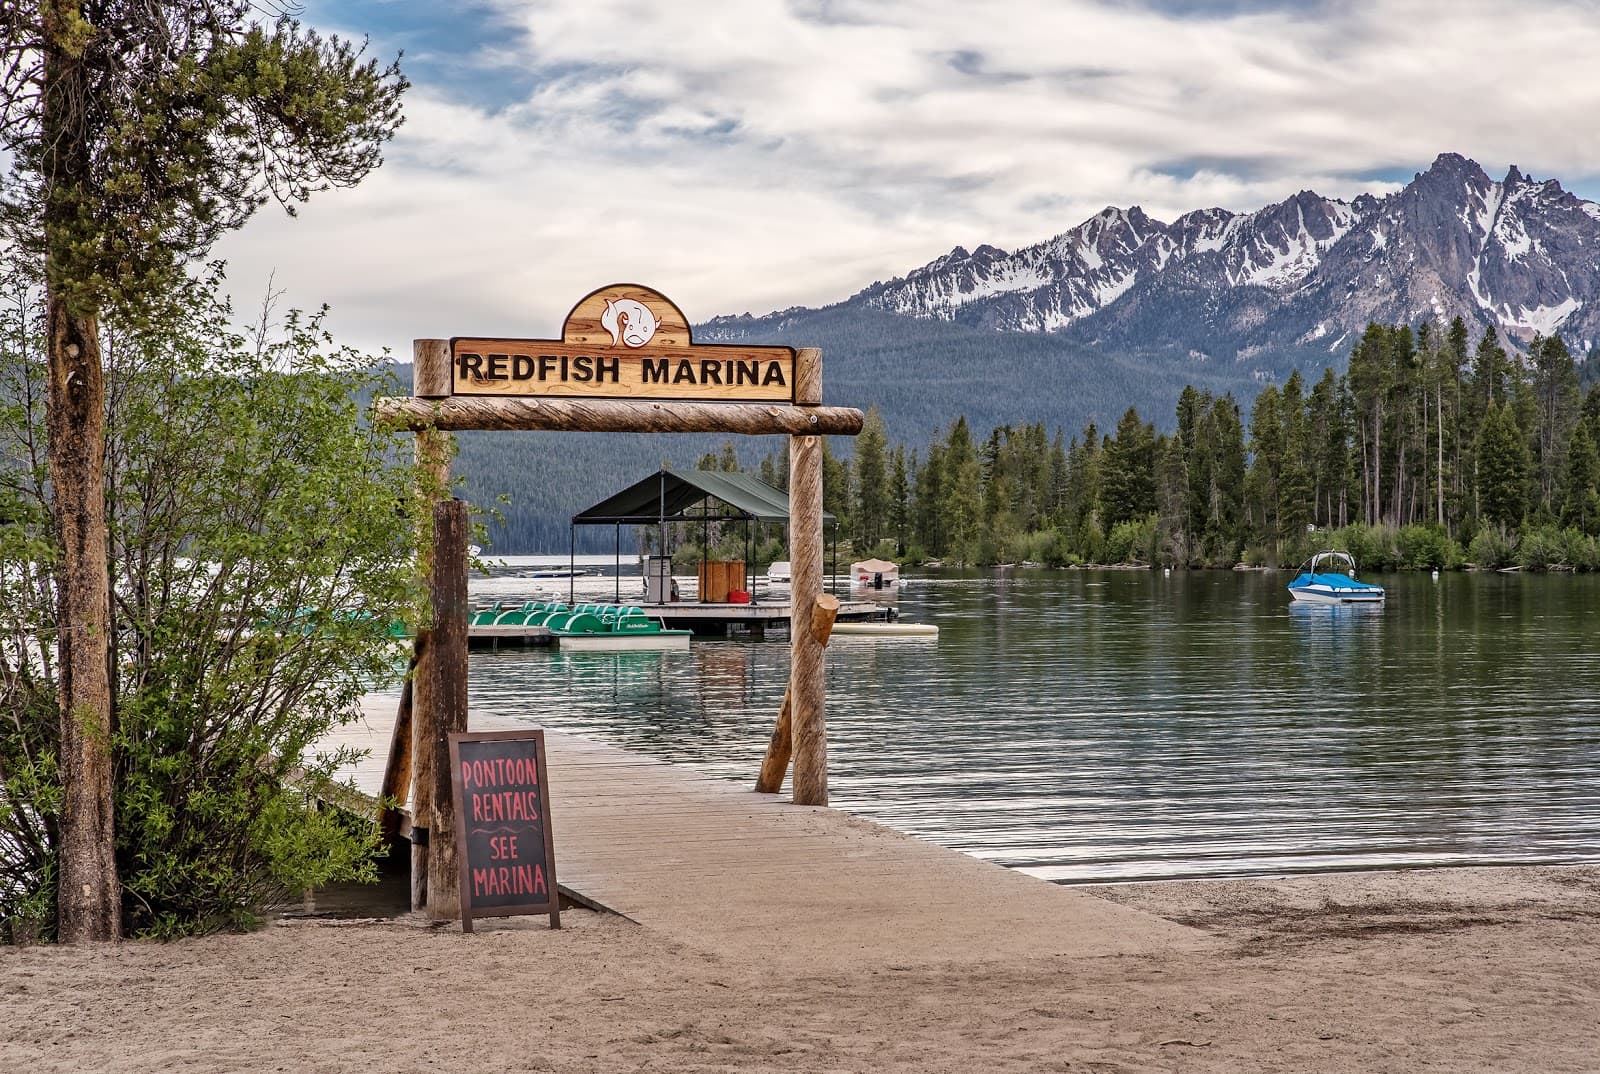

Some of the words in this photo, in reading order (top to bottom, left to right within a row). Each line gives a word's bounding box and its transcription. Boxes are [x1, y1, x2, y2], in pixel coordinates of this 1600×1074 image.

[459, 353, 620, 383] REDFISH
[642, 358, 786, 386] MARINA
[462, 758, 537, 788] PONTOON
[473, 791, 537, 821] RENTALS
[490, 837, 518, 859] SEE
[474, 864, 546, 896] MARINA
